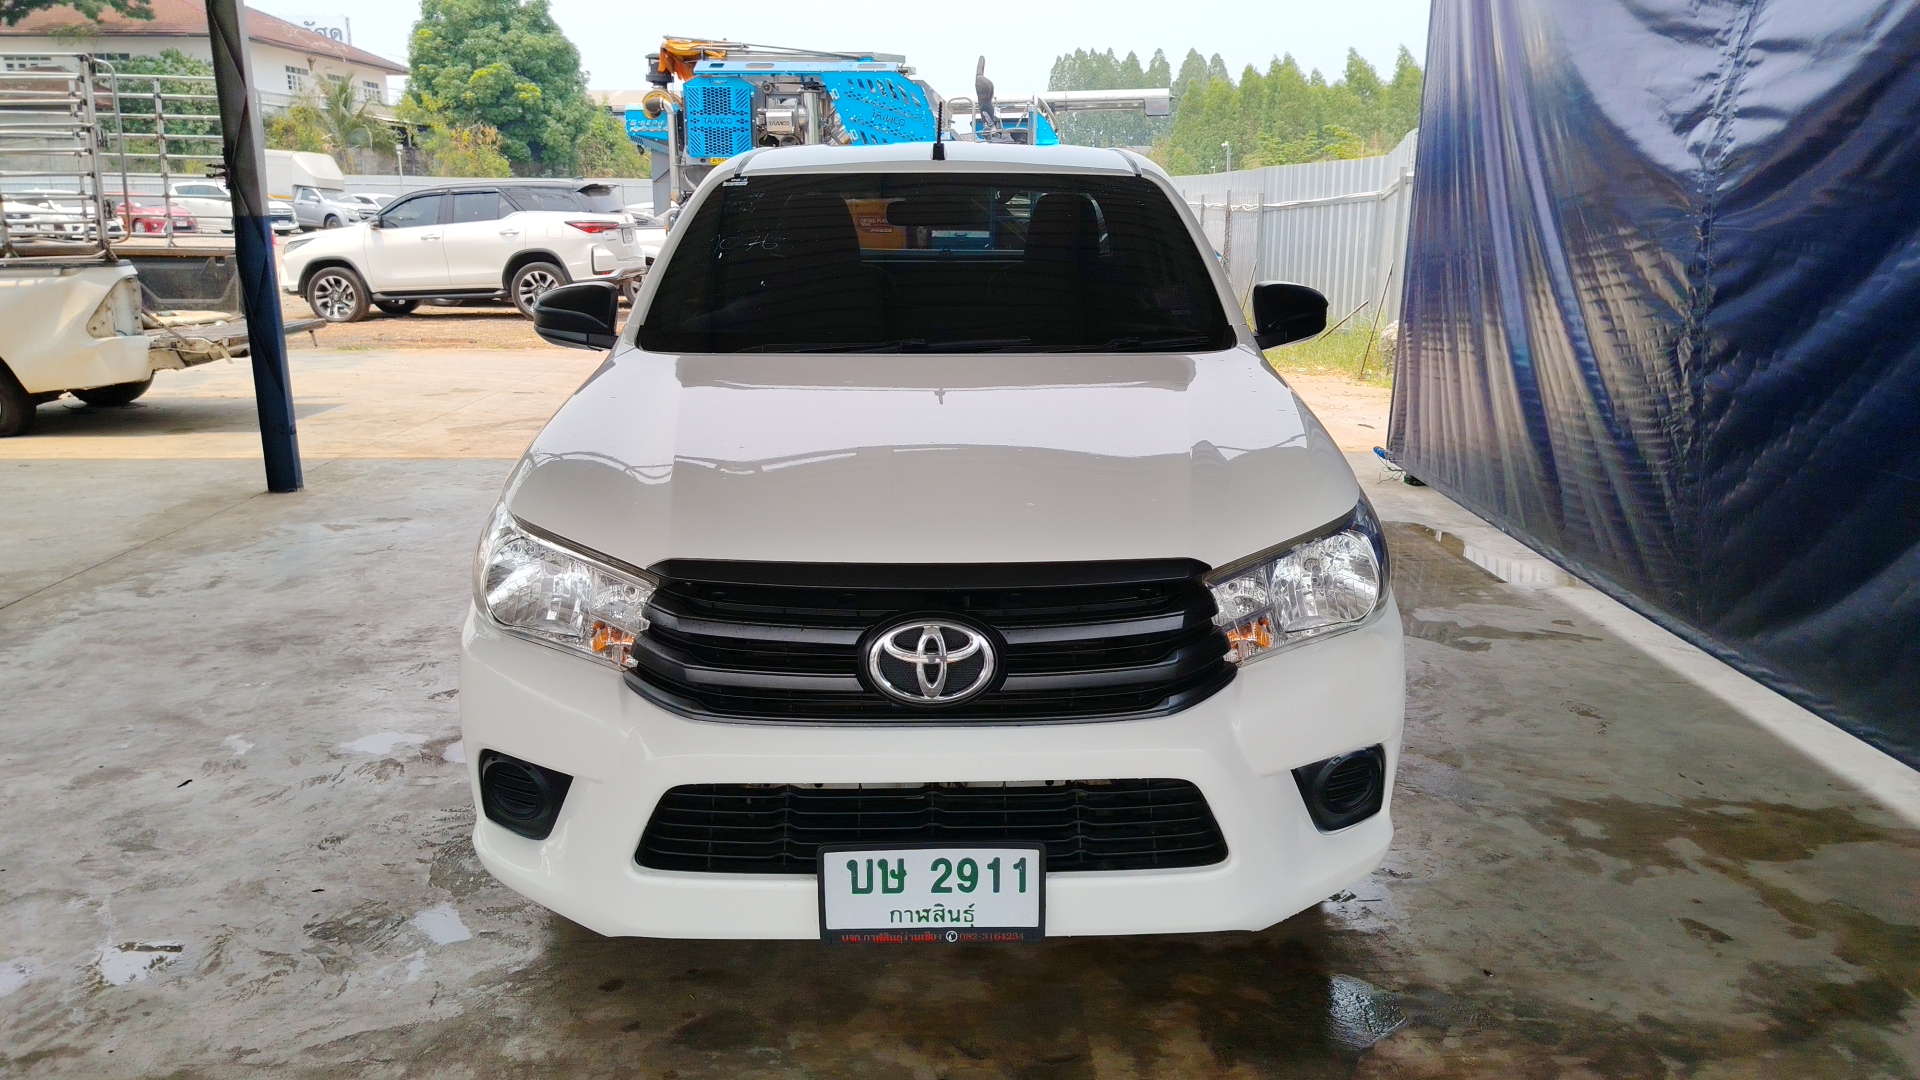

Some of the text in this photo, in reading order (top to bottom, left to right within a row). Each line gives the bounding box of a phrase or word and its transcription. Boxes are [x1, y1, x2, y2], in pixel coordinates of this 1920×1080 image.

[703, 117, 733, 125] TAMCO
[872, 109, 906, 127] TAMCO
[846, 856, 1027, 895] บษ 2911
[889, 903, 975, 928] กาฬสินธุ์
